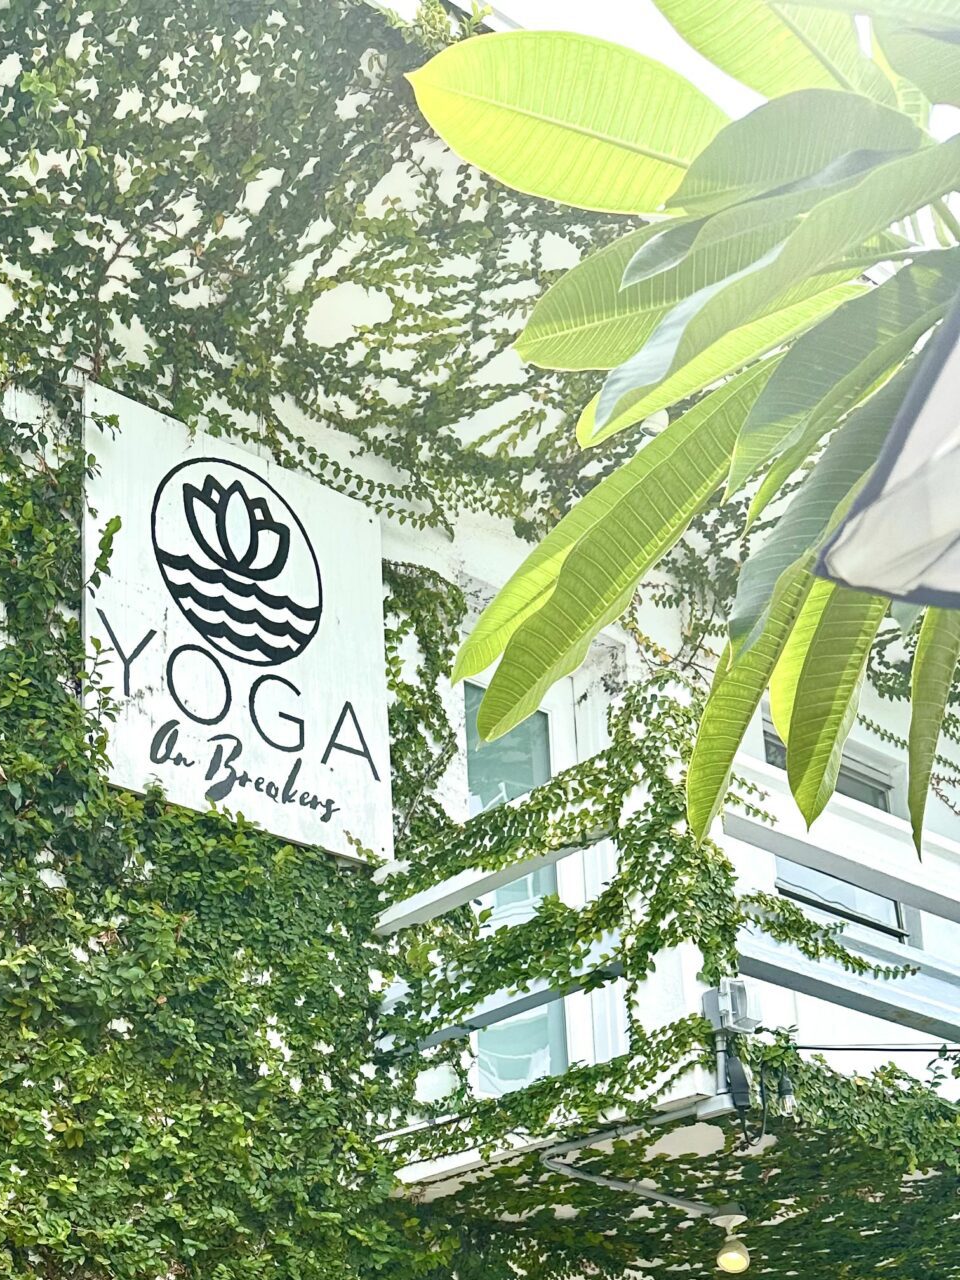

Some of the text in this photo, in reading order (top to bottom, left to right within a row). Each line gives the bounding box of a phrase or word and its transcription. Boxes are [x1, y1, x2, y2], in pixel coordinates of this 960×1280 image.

[96, 608, 380, 782] YOGA
[150, 719, 341, 823] On Breakers
